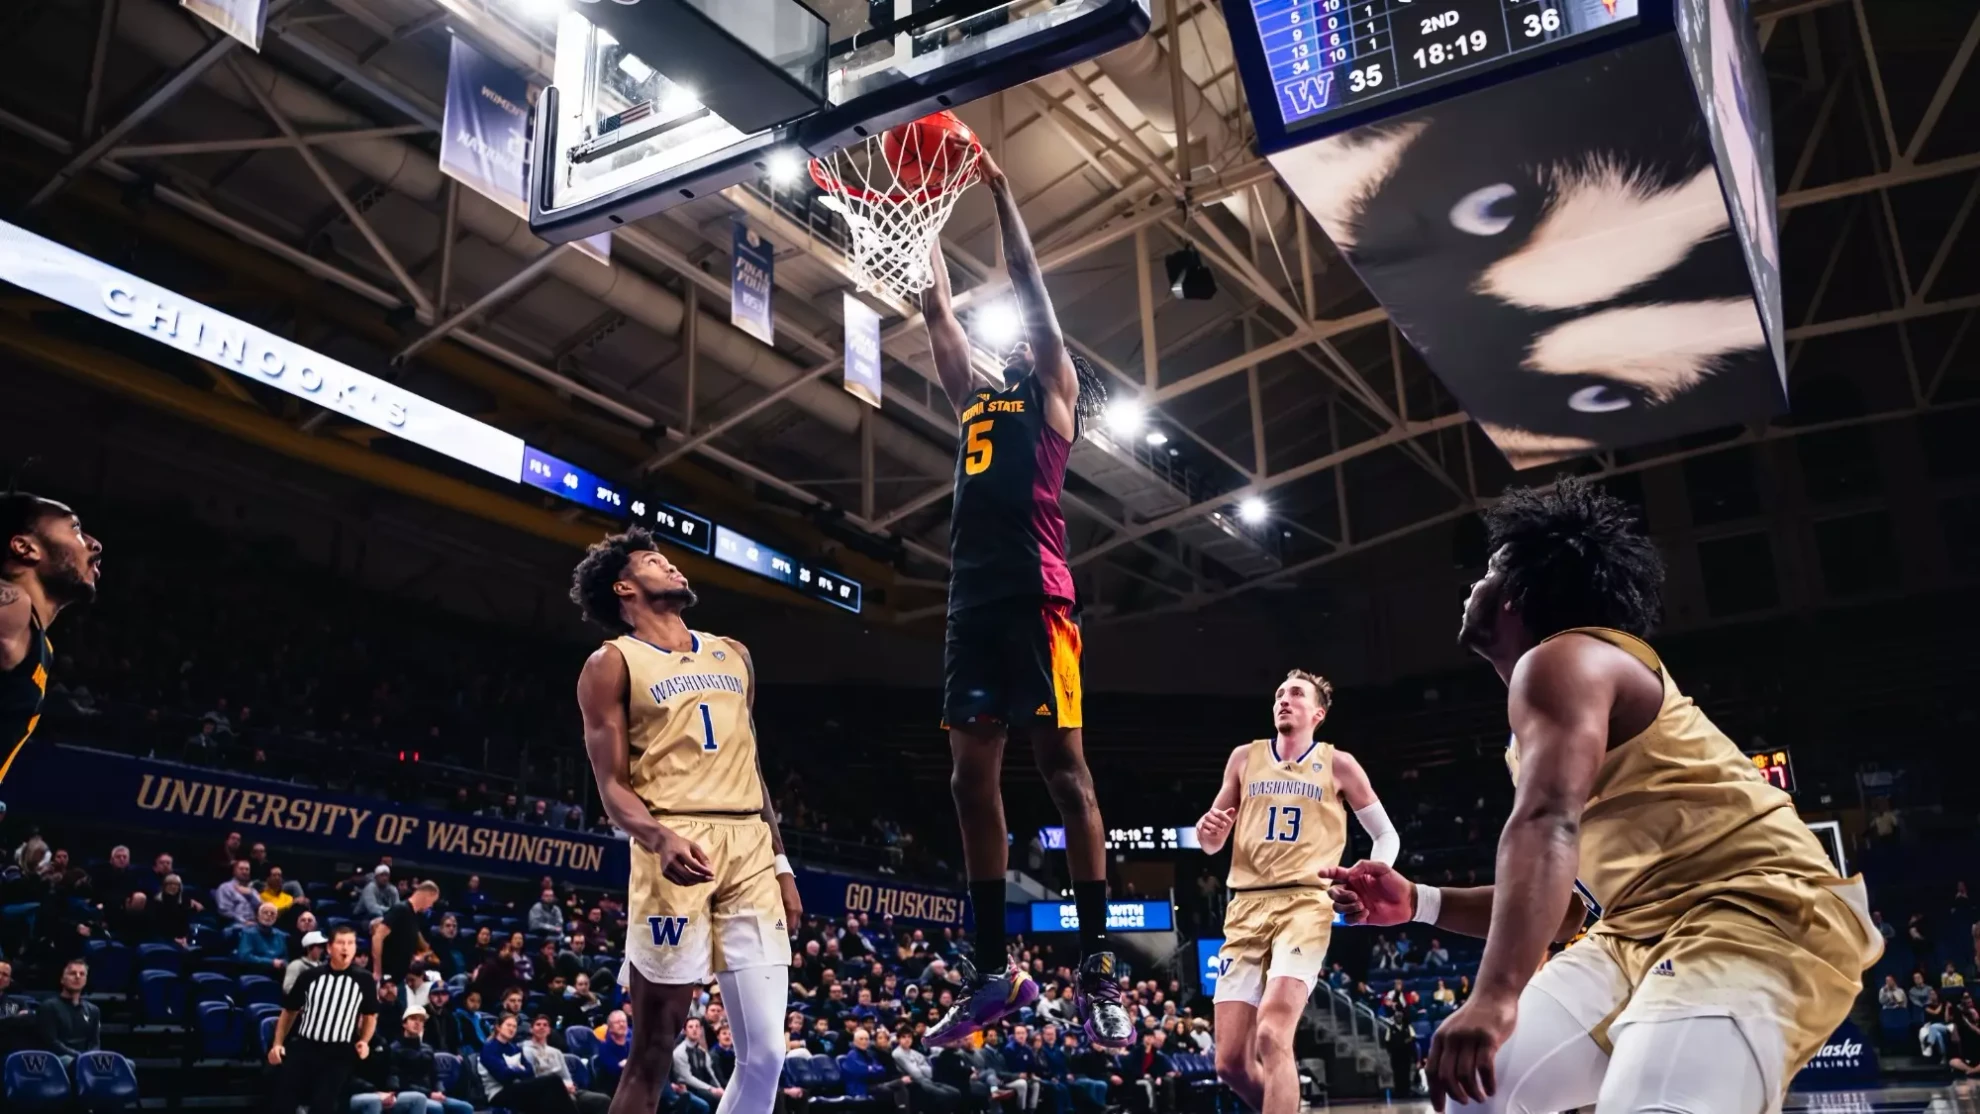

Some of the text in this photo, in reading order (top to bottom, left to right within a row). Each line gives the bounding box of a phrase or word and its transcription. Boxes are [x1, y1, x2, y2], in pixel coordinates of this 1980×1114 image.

[1290, 0, 1339, 24] 5 10
[1292, 5, 1372, 42] 9 0 1
[1420, 10, 1460, 35] 2ND
[1523, 8, 1560, 38] 36
[1291, 21, 1374, 59] 13 6 1
[1292, 38, 1377, 75] 34 10 1
[1412, 30, 1488, 69] 18:19
[1284, 63, 1383, 114] W 35
[987, 400, 1025, 413] STATE
[965, 419, 995, 476] 5
[650, 674, 744, 704] WASHINGTON
[699, 703, 718, 751] 1
[1248, 780, 1323, 802] WASHINGTON
[137, 774, 605, 873] UNIVERSITY OF WASHINGTON
[1265, 805, 1303, 842] 13
[845, 883, 965, 924] GO HUSKIES!
[1108, 904, 1144, 917] WITH
[647, 915, 689, 947] W
[1813, 1038, 1862, 1058] laska
